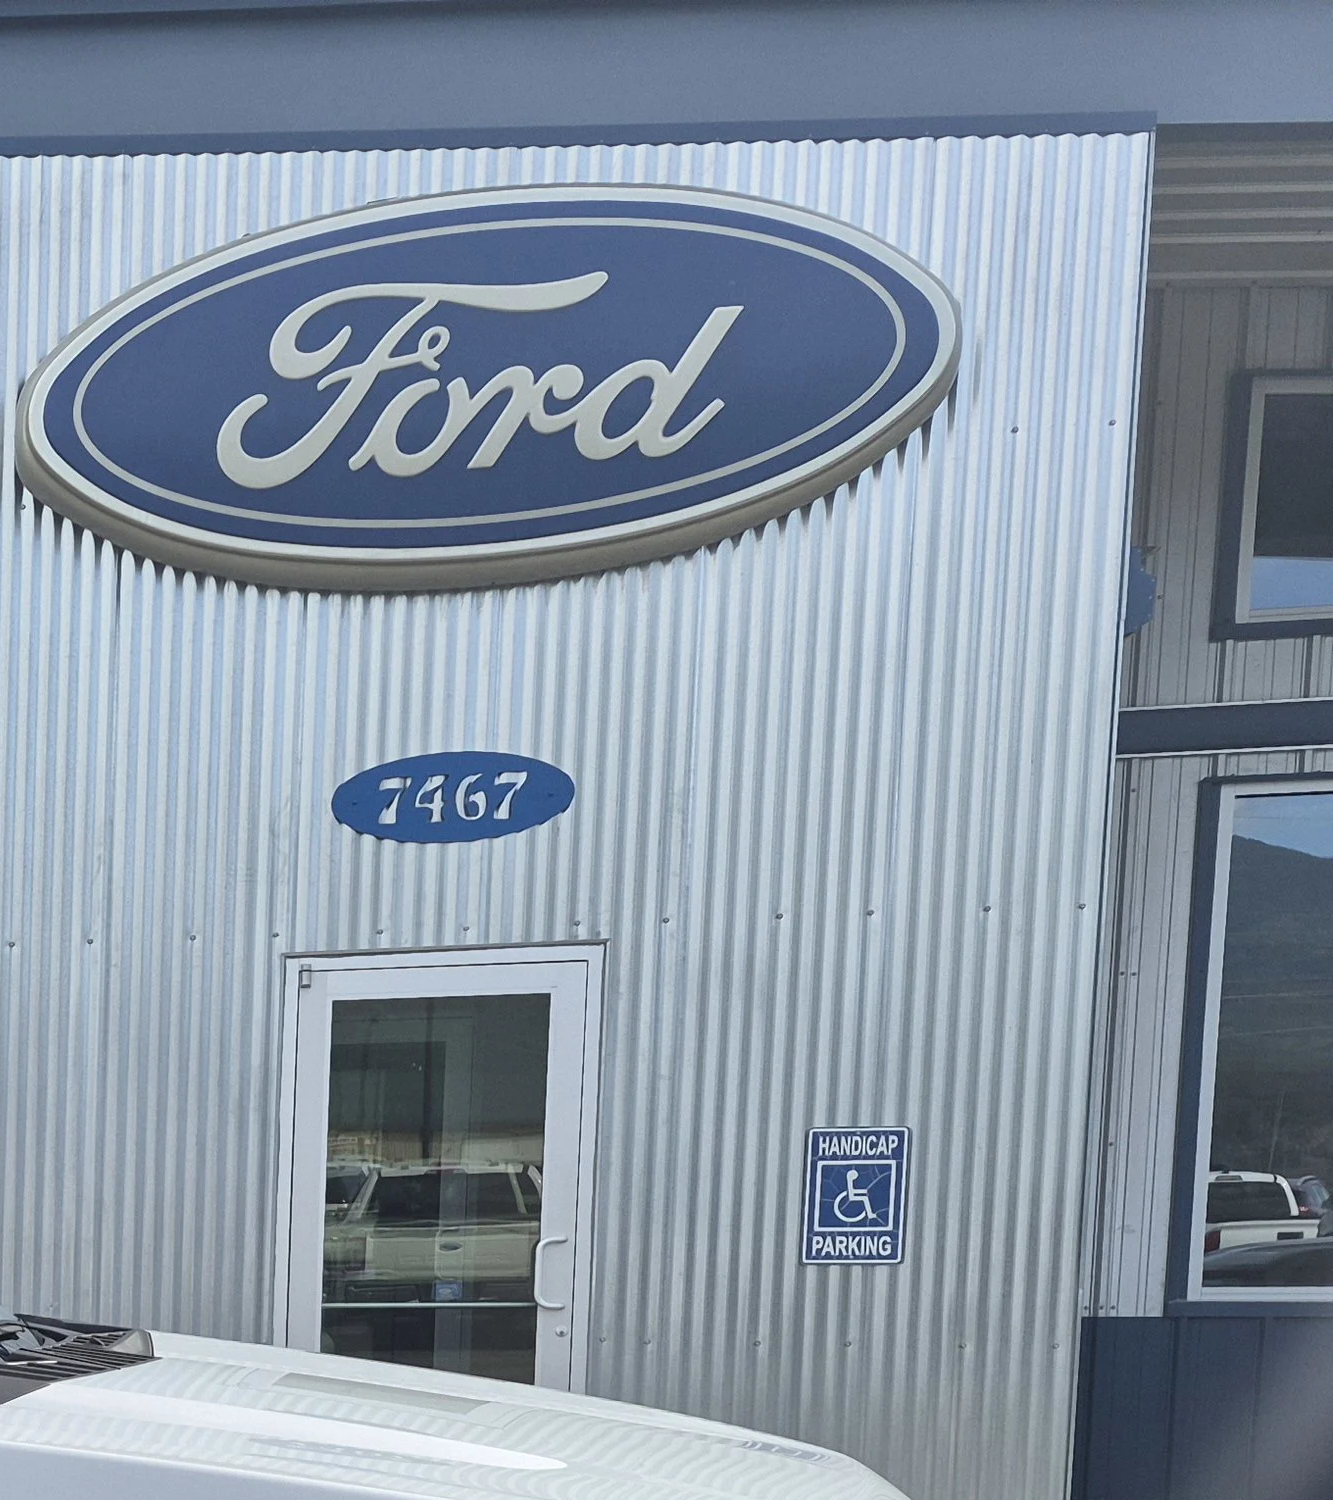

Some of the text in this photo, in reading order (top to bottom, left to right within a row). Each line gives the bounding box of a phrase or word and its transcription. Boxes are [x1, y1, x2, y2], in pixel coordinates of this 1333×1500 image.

[217, 271, 744, 489] Ford
[378, 771, 528, 824] 7467
[818, 1134, 898, 1157] HANDICAP
[812, 1234, 891, 1257] PARKING
